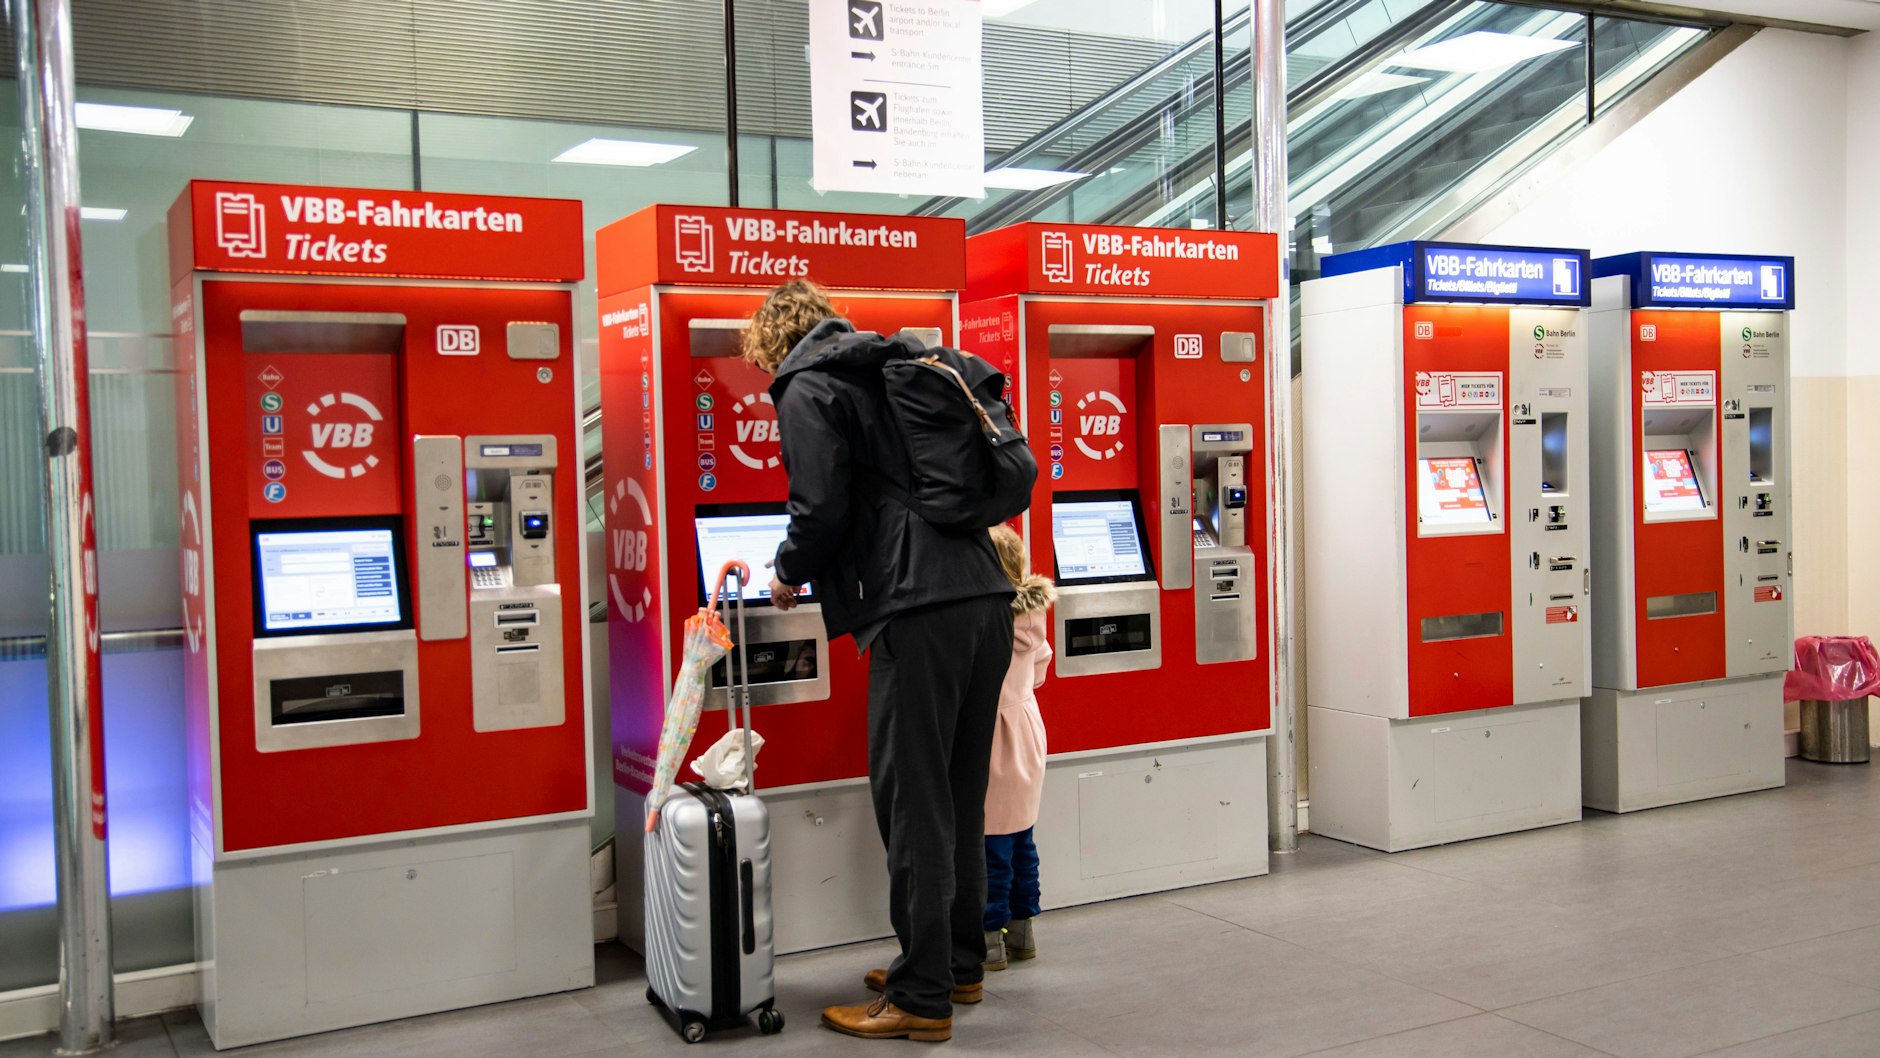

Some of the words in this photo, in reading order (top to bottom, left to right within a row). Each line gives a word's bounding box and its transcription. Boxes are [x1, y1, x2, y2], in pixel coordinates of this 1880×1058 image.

[889, 4, 916, 14] Tickets
[928, 8, 950, 16] Berlin
[889, 16, 914, 25] airport
[916, 18, 940, 27] and/or
[942, 20, 960, 29] local
[889, 27, 924, 36] transport
[891, 48, 920, 57] S-Bahn
[922, 50, 971, 63] Kundencenter
[892, 61, 925, 69] entrance
[894, 92, 920, 101] Tickets
[893, 104, 930, 115] Flughafen
[893, 116, 928, 125] innerhalb
[894, 170, 926, 179] nebenan
[280, 196, 523, 233] VBB-Fahrkarten
[726, 217, 918, 248] VBB-Fahrkarten
[286, 234, 388, 263] Tickets
[1082, 233, 1239, 260] VBB-Fahrkarten
[729, 251, 809, 276] Tickets
[1427, 254, 1544, 279] VBB-Fahrkarten
[1085, 263, 1150, 286] Tickets
[1652, 263, 1752, 285] VBB-Fahrkarten
[979, 331, 1000, 344] Tickets
[1418, 325, 1430, 336] DB
[1534, 326, 1544, 340] S
[1642, 328, 1654, 338] DB
[1743, 327, 1751, 341] S
[442, 329, 475, 351] DB
[1178, 338, 1200, 354] DB
[1005, 375, 1012, 388] S
[264, 394, 280, 411] S
[699, 395, 711, 410] S
[1050, 392, 1059, 405] S
[700, 415, 711, 429] U
[1051, 411, 1060, 423] U
[266, 417, 279, 433] U
[1080, 415, 1121, 436] VBB
[311, 423, 374, 448] VBB
[266, 466, 283, 474] BUS
[1052, 464, 1060, 477] F
[702, 475, 713, 488] F
[268, 484, 280, 499] F
[613, 529, 648, 572] VBB
[616, 759, 654, 784] Berlin-Brandenb
